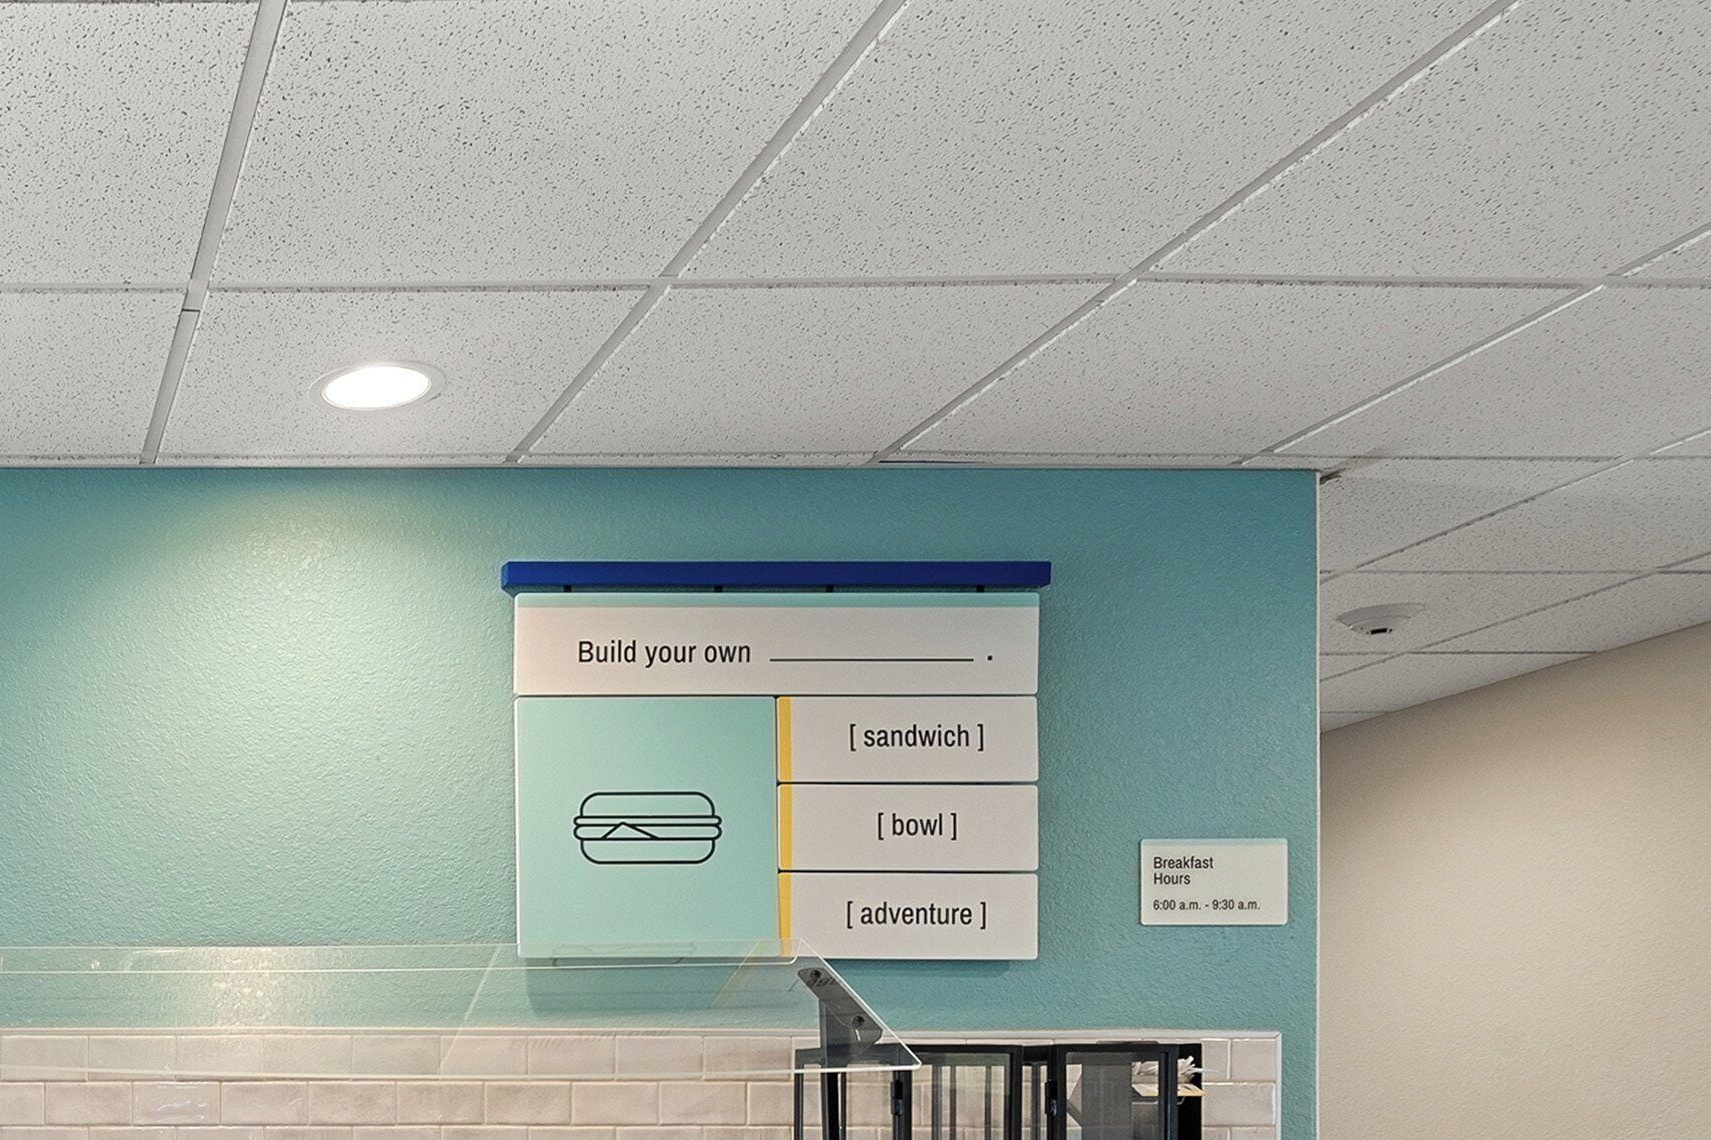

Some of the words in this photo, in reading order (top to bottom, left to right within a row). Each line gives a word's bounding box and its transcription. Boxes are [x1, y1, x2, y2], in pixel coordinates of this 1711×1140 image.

[578, 639, 637, 663] Build
[644, 645, 697, 669] your
[704, 645, 751, 663] own
[1153, 856, 1214, 869] Breakfast
[1153, 873, 1191, 885] Hours
[1153, 899, 1177, 911] 6:00
[1179, 900, 1202, 911] a.m.
[1212, 899, 1235, 911] 9:30
[1237, 900, 1261, 911] a.m.
